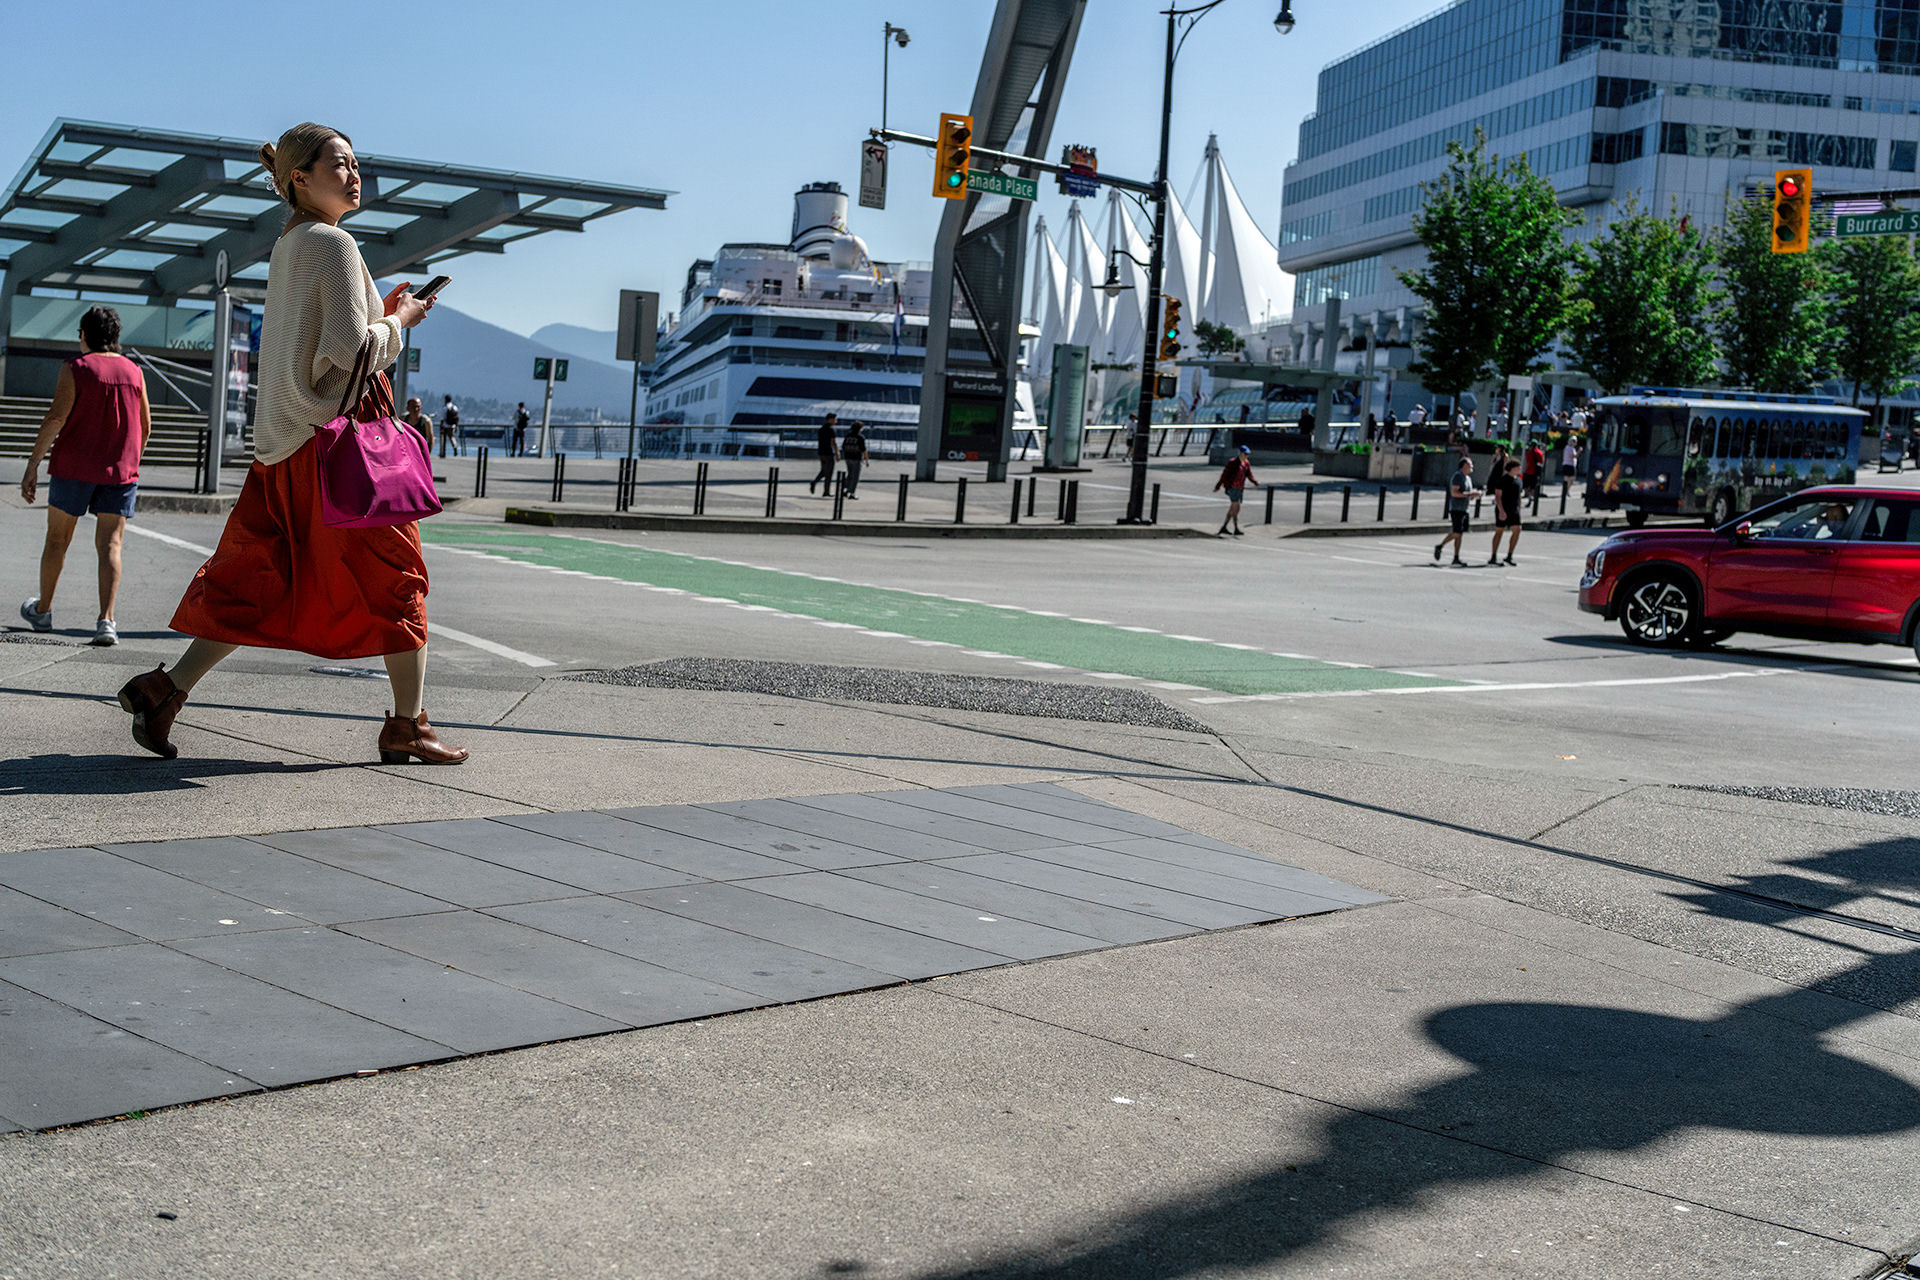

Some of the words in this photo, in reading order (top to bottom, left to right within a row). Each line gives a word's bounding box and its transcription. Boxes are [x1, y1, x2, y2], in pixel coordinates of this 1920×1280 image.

[967, 175, 1001, 192] anada
[1006, 179, 1033, 197] Place
[1846, 214, 1904, 233] Burrard
[1910, 214, 1920, 230] S
[169, 339, 215, 351] VANCO
[953, 381, 977, 391] Burrard
[978, 382, 1003, 394] Landing
